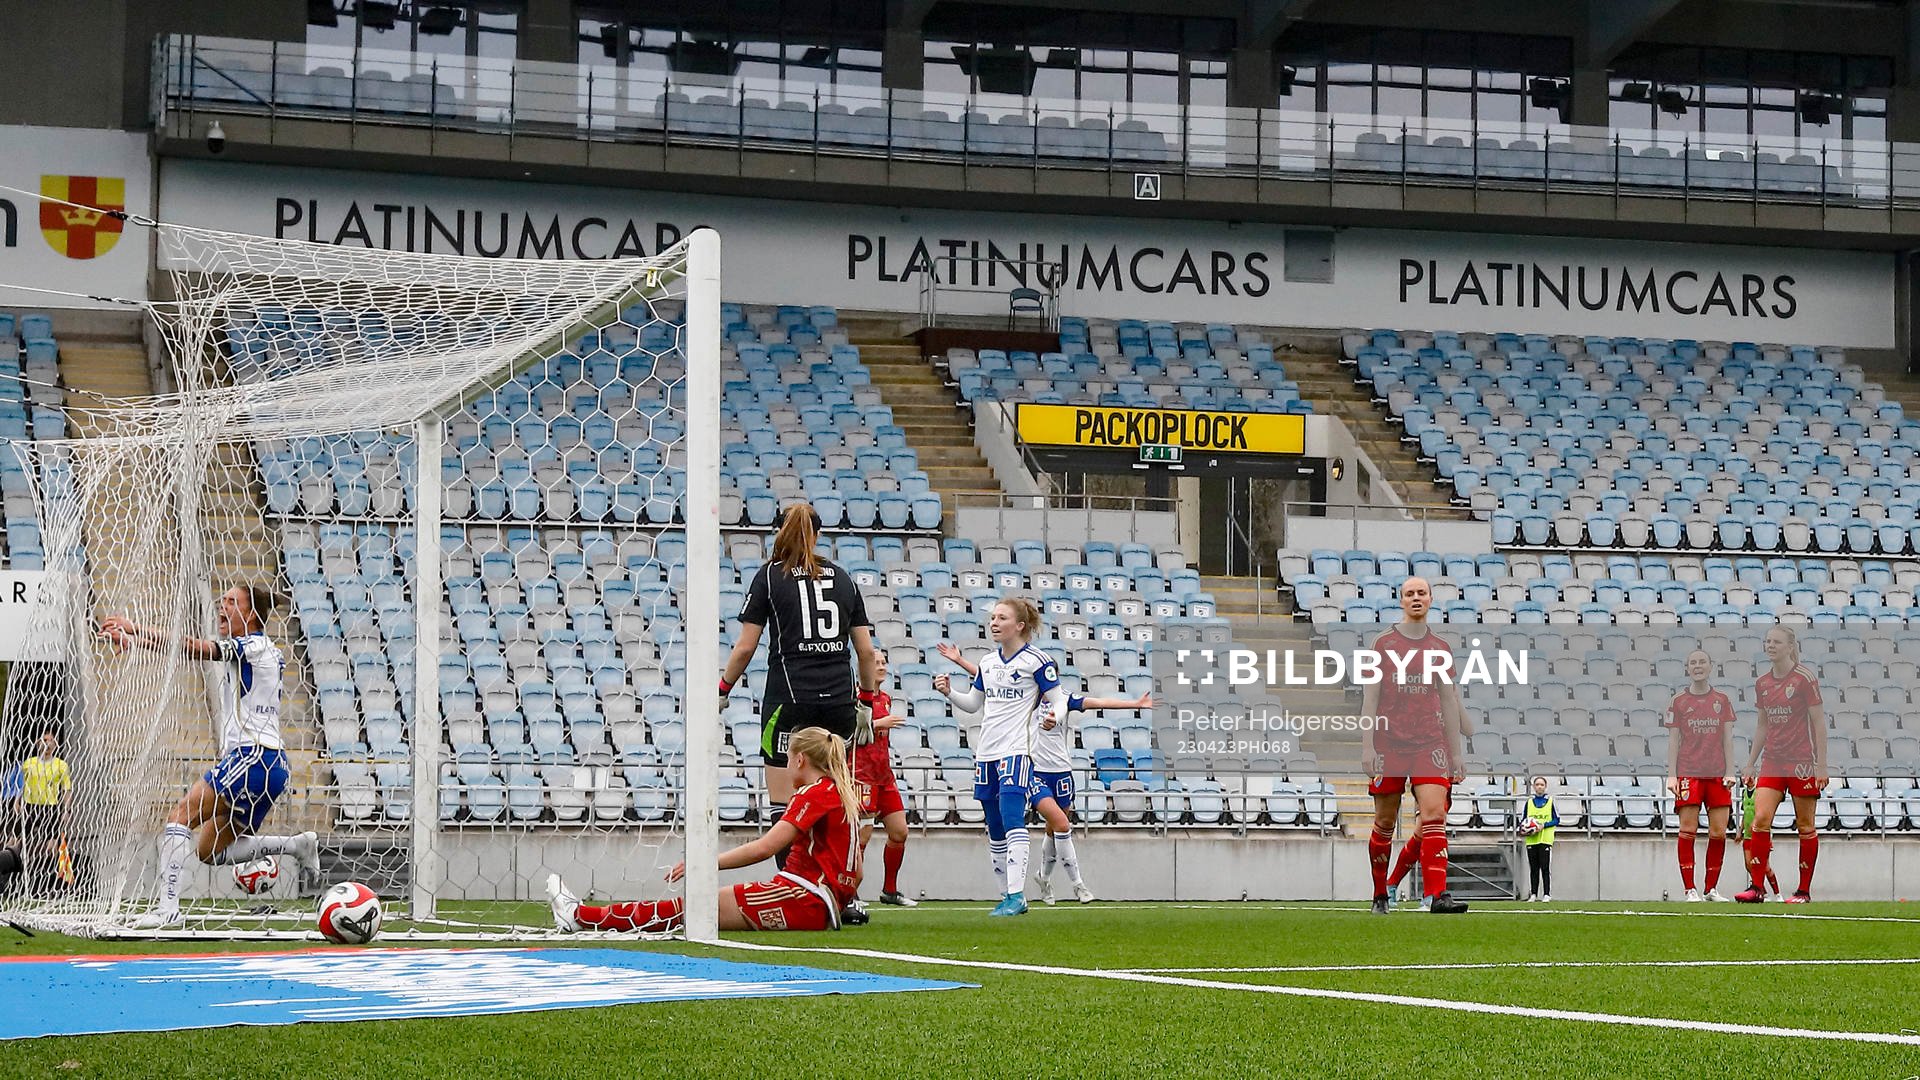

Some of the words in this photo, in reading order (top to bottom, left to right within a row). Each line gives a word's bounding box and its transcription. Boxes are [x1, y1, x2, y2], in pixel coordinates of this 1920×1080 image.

[1138, 176, 1157, 197] A
[275, 197, 710, 259] PLATINUMCAR
[848, 234, 1270, 297] PLATINUMCARS
[1399, 258, 1797, 319] PLATINUMCARS
[1075, 410, 1248, 449] PACKOPLOCK
[797, 579, 840, 639] 15
[985, 688, 1024, 699] OLMEN
